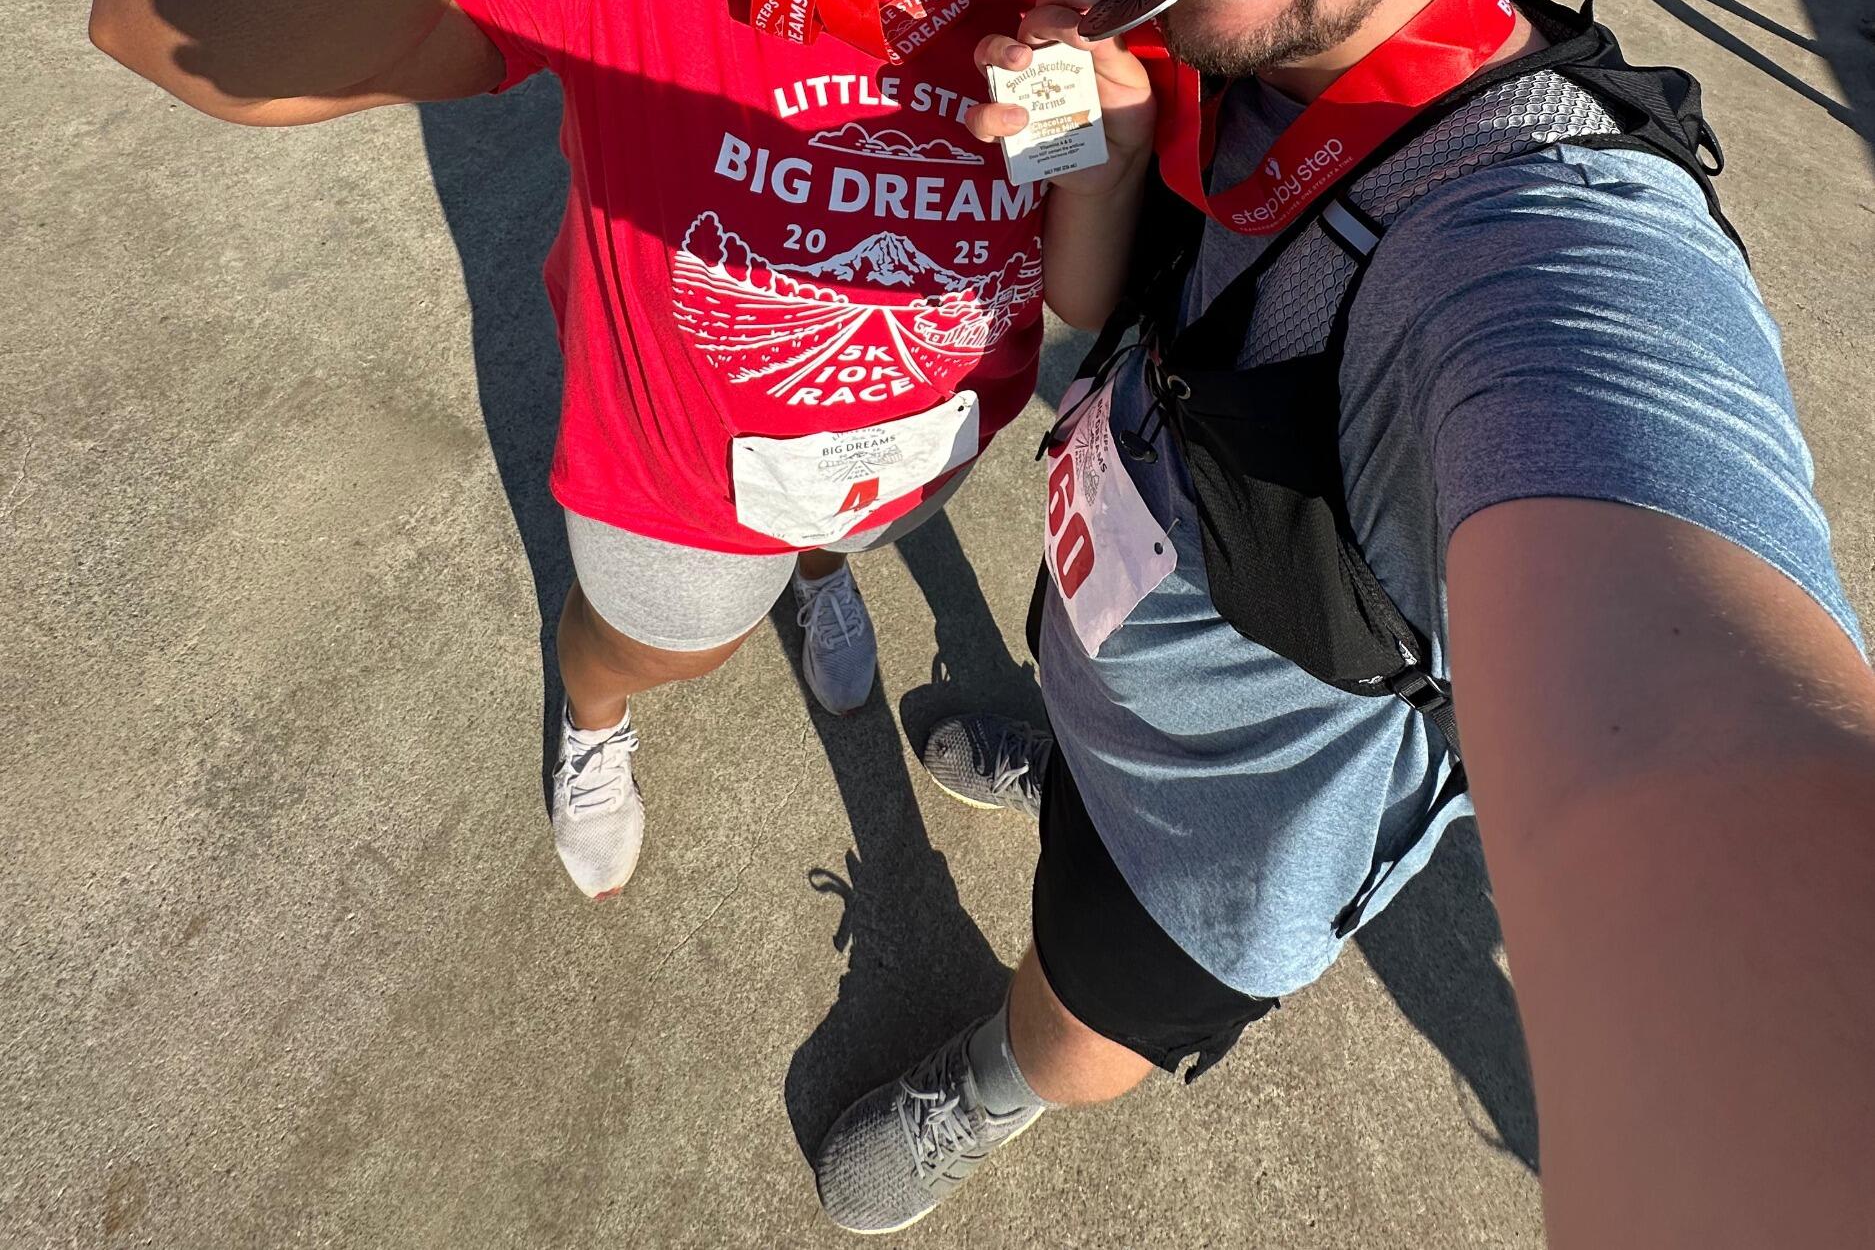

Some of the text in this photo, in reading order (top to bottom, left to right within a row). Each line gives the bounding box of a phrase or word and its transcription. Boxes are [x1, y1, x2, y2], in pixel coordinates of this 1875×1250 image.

[1006, 60, 1084, 93] Smith Brothers
[774, 75, 980, 124] LITTLE STE
[1031, 97, 1066, 111] Farms
[714, 132, 813, 204] BIG
[1232, 138, 1343, 225] step by step
[783, 224, 827, 254] 20
[953, 241, 990, 264] 25
[838, 345, 893, 361] 5K
[814, 366, 903, 383] 10K
[787, 377, 914, 405] RACE
[822, 444, 842, 457] BIG
[846, 435, 896, 452] DREAMS
